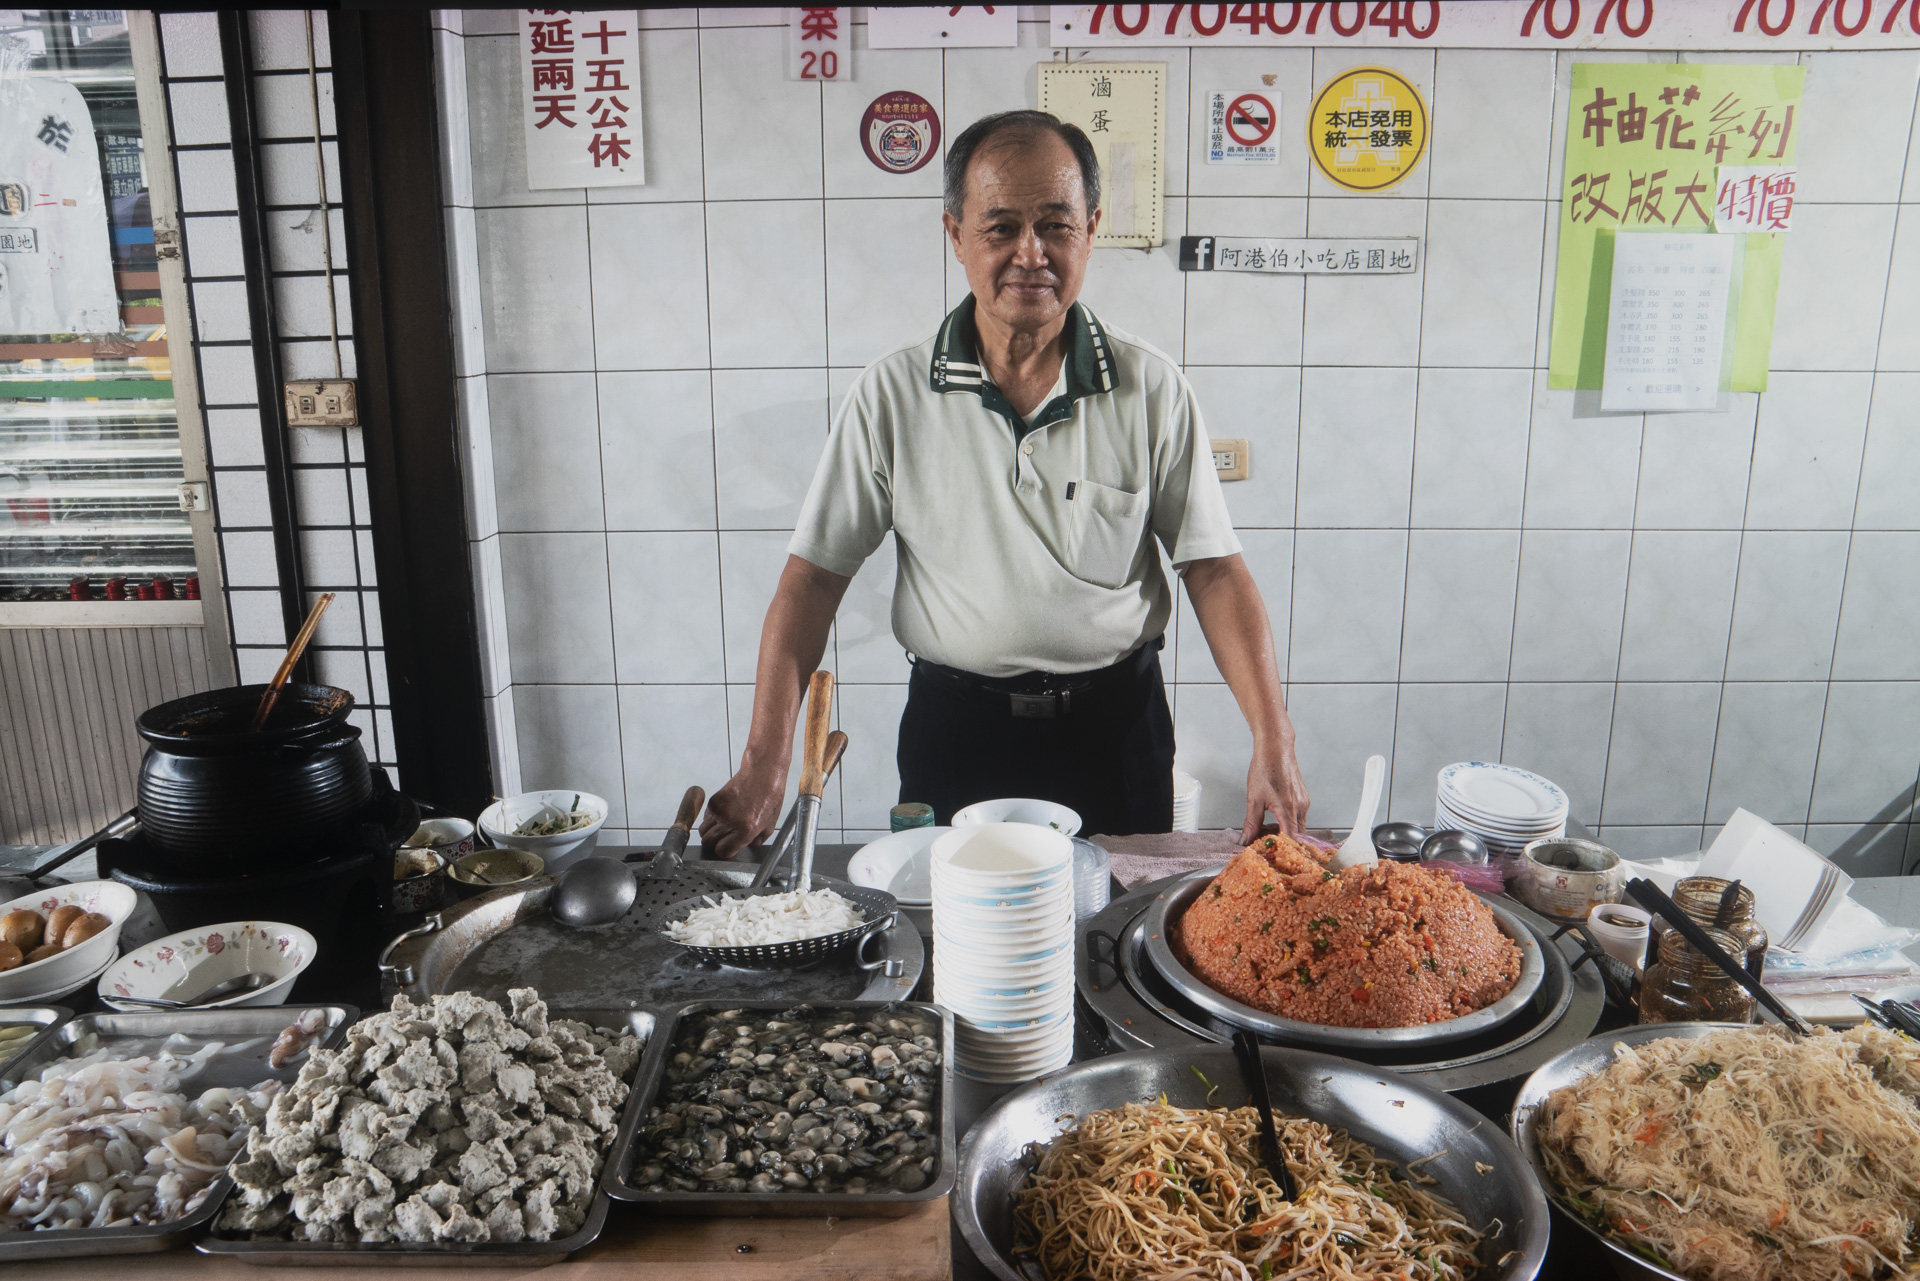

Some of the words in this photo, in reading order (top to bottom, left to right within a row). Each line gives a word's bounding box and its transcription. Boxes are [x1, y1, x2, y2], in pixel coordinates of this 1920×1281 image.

[528, 9, 578, 129] 延兩天
[800, 50, 837, 79] 20
[582, 20, 631, 168] 十五公休
[1090, 75, 1113, 133] 滷蛋
[1325, 110, 1412, 128] 本店免用
[1325, 129, 1413, 148] 統一發票
[1583, 84, 1795, 164] 柚花系列
[1571, 169, 1710, 228] 改版大
[1716, 171, 1797, 230] 特價
[0, 236, 33, 252] 園地
[1220, 248, 1412, 270] 阿港伯小吃店園地
